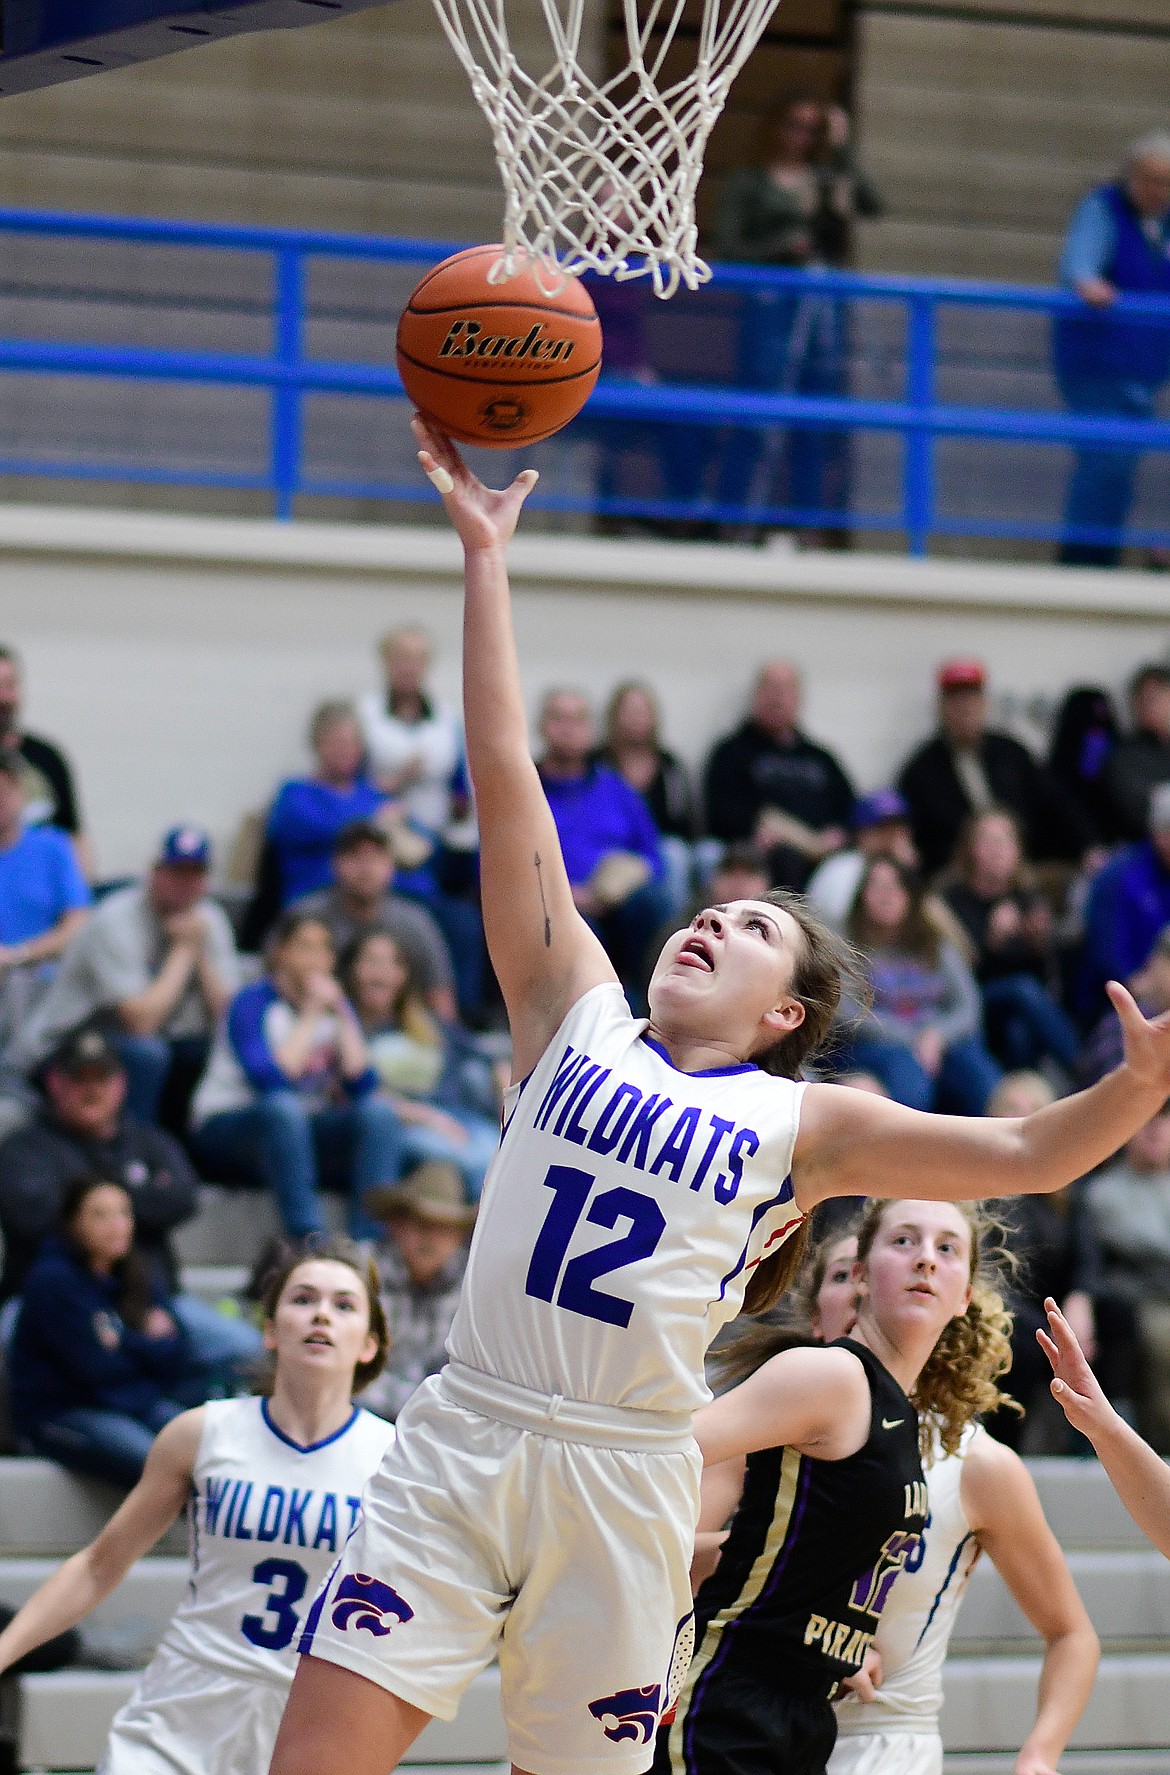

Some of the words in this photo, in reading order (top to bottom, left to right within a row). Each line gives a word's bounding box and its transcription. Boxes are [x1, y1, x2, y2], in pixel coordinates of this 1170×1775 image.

[438, 320, 575, 363] Baden
[533, 1045, 760, 1206] WILDKATS
[525, 1165, 667, 1329] 12
[241, 1558, 309, 1651] 3
